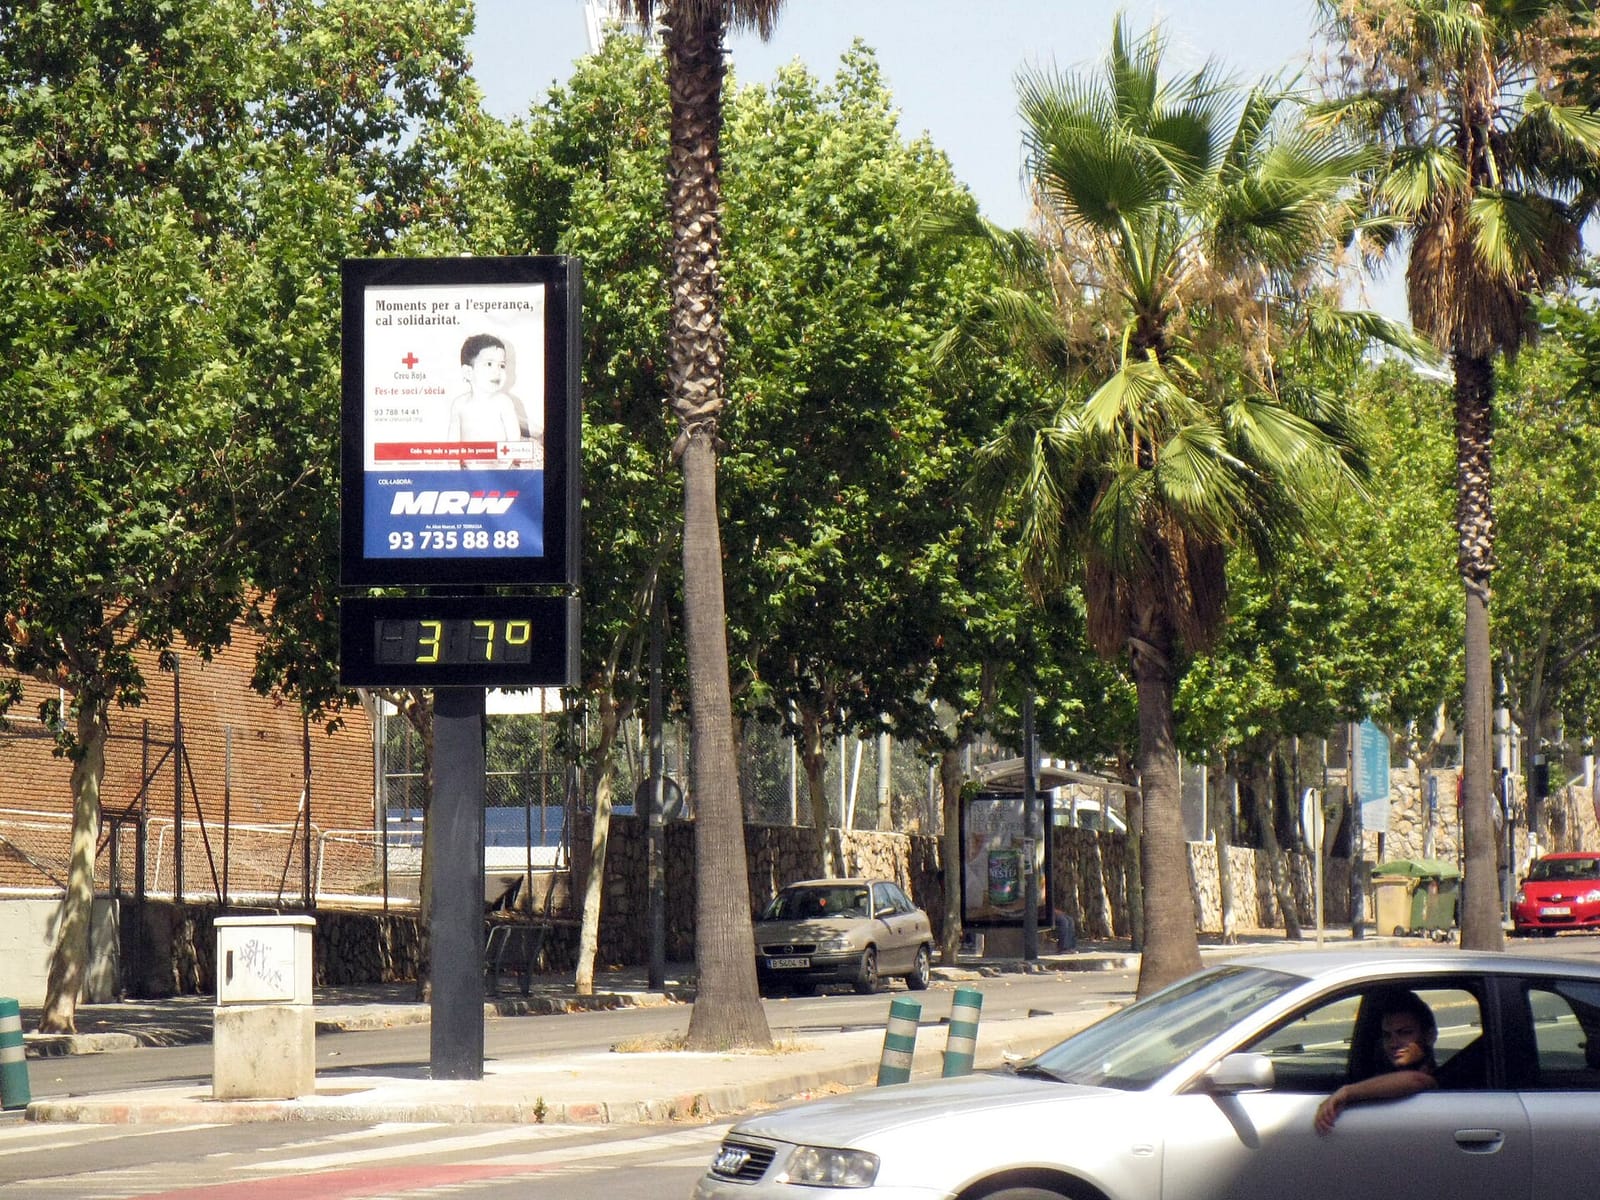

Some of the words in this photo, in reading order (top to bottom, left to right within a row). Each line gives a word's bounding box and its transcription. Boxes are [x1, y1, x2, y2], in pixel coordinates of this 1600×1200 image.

[375, 300, 427, 311] Moments
[431, 302, 450, 313] per
[465, 299, 534, 312] l'esperança,
[375, 314, 393, 326] cal
[397, 314, 461, 326] solidaritat.
[393, 371, 410, 380] Creu
[411, 371, 427, 381] Roja
[390, 490, 520, 515] MRW
[388, 531, 414, 550] 93
[420, 531, 458, 550] 735
[463, 530, 489, 550] 88
[493, 530, 520, 550] 88
